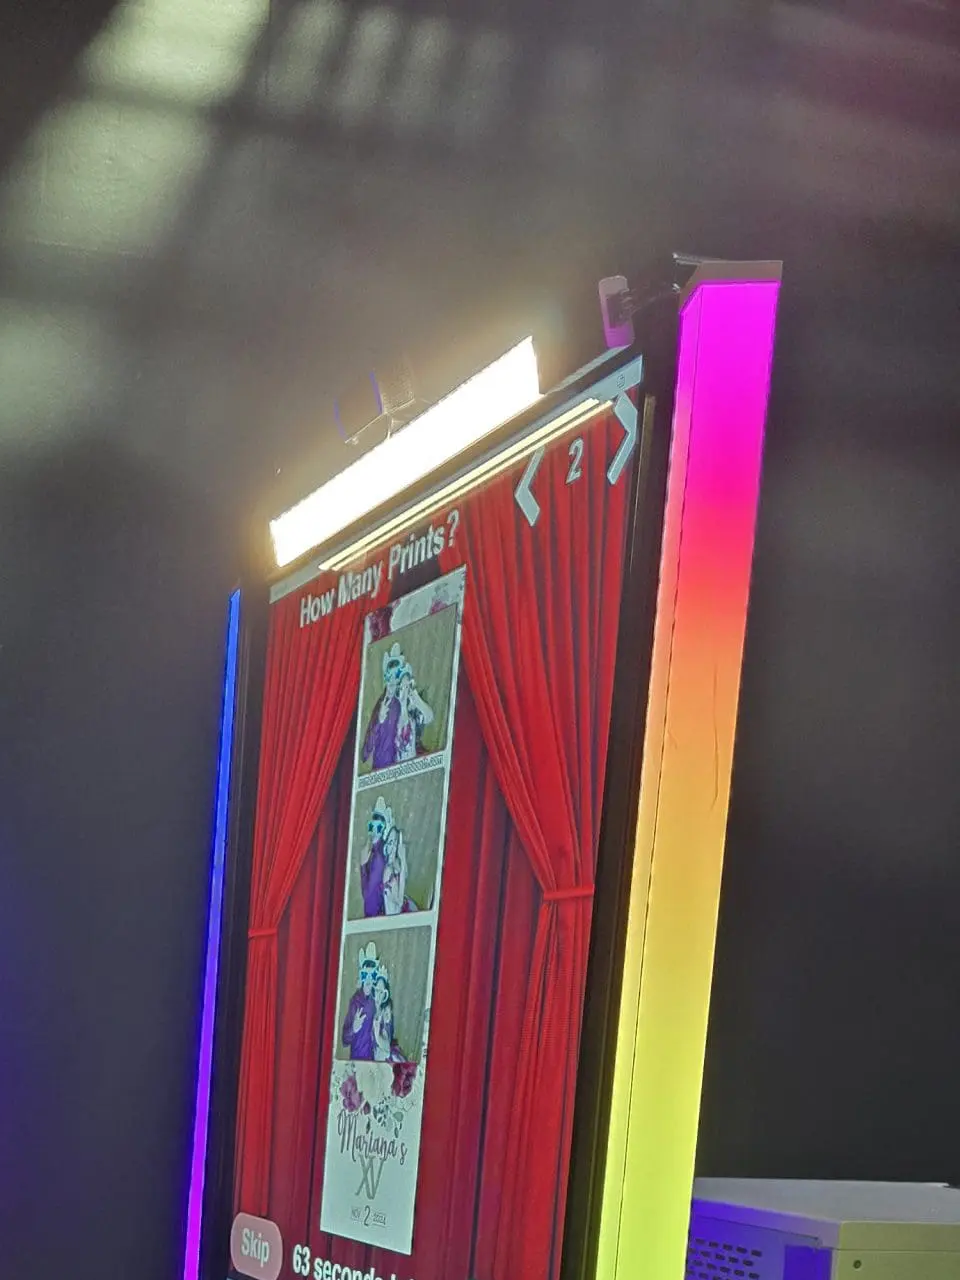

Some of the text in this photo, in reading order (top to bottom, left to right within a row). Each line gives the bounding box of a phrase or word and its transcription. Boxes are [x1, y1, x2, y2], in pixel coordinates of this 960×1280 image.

[565, 437, 584, 485] 2
[300, 509, 459, 628] How Many Prints?
[355, 1153, 387, 1200] XV
[241, 1227, 270, 1267] Skip
[293, 1244, 310, 1277] 63
